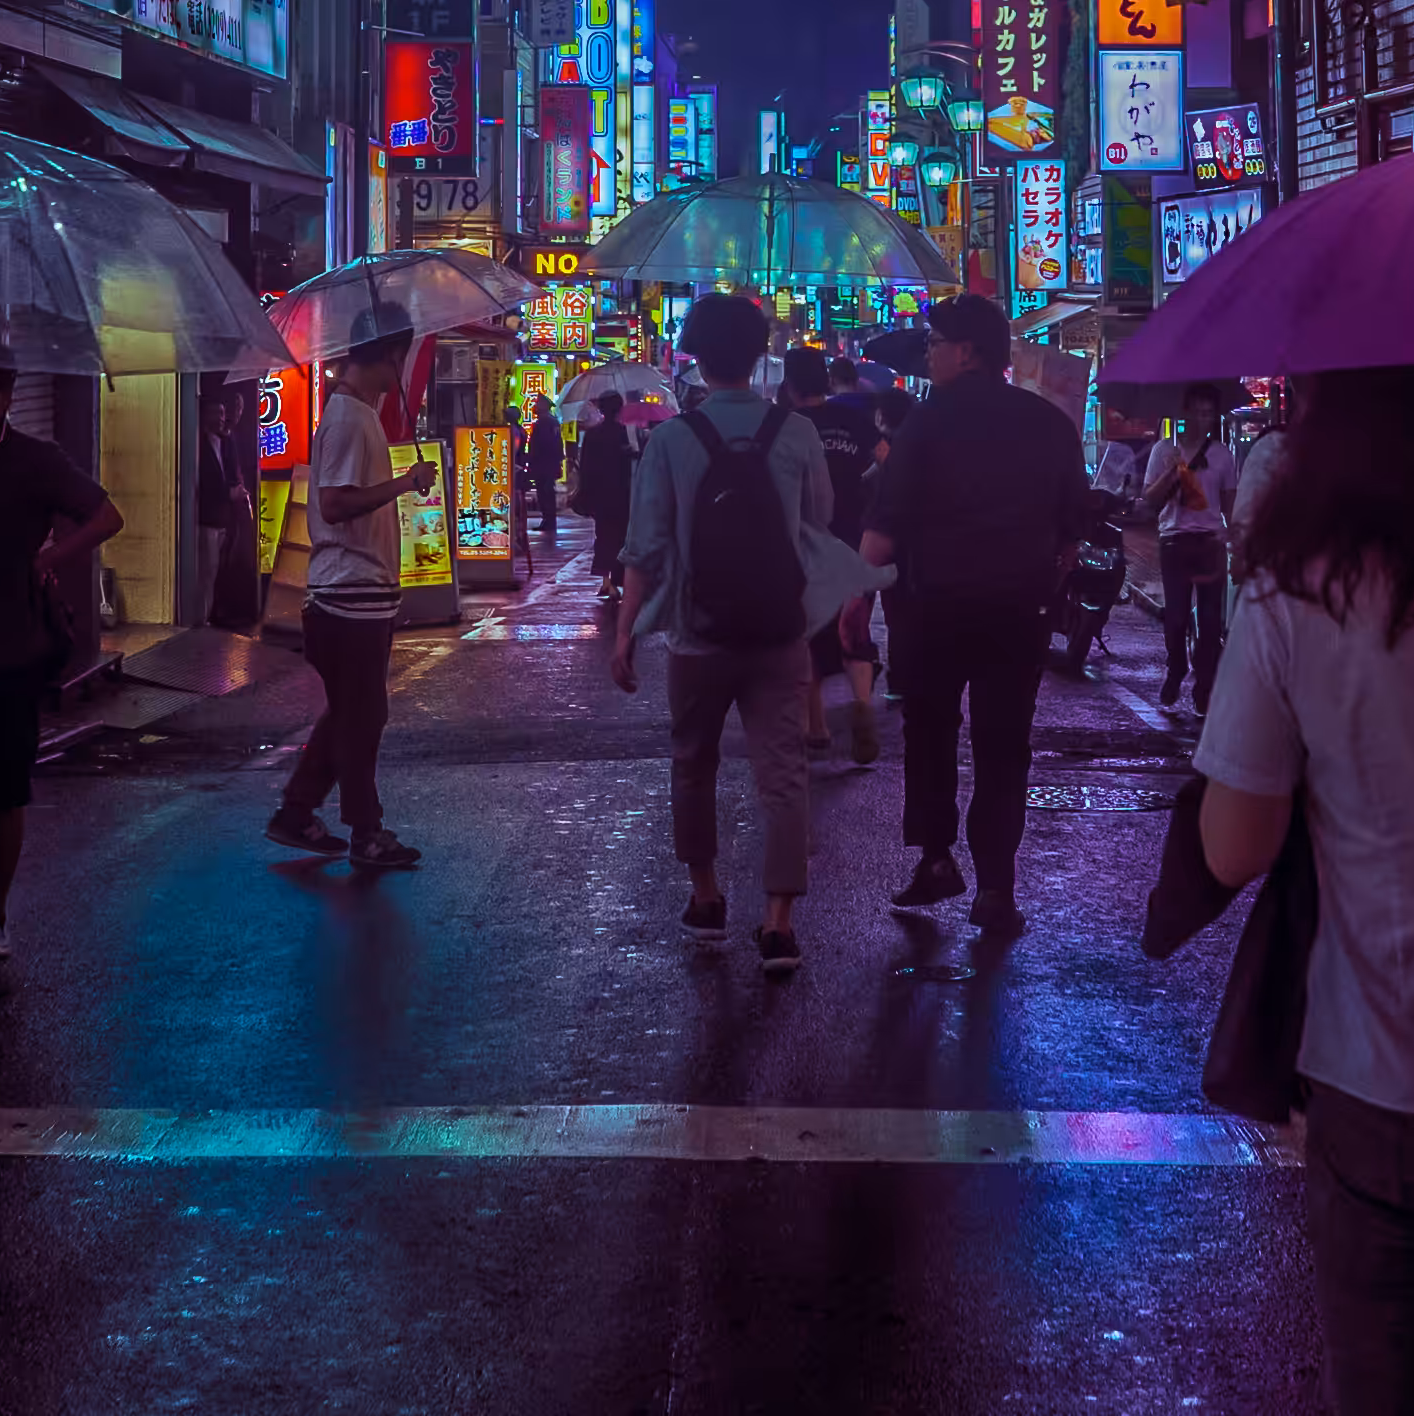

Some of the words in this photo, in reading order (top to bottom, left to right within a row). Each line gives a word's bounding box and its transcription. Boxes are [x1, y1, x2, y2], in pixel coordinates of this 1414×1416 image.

[427, 47, 460, 153] やきとり
[1127, 73, 1156, 152] わがや
[1021, 164, 1040, 227] パセラ
[1044, 164, 1064, 249] カラオケ
[536, 253, 579, 275] NO
[530, 290, 588, 319] 風俗
[530, 320, 588, 349] 案内
